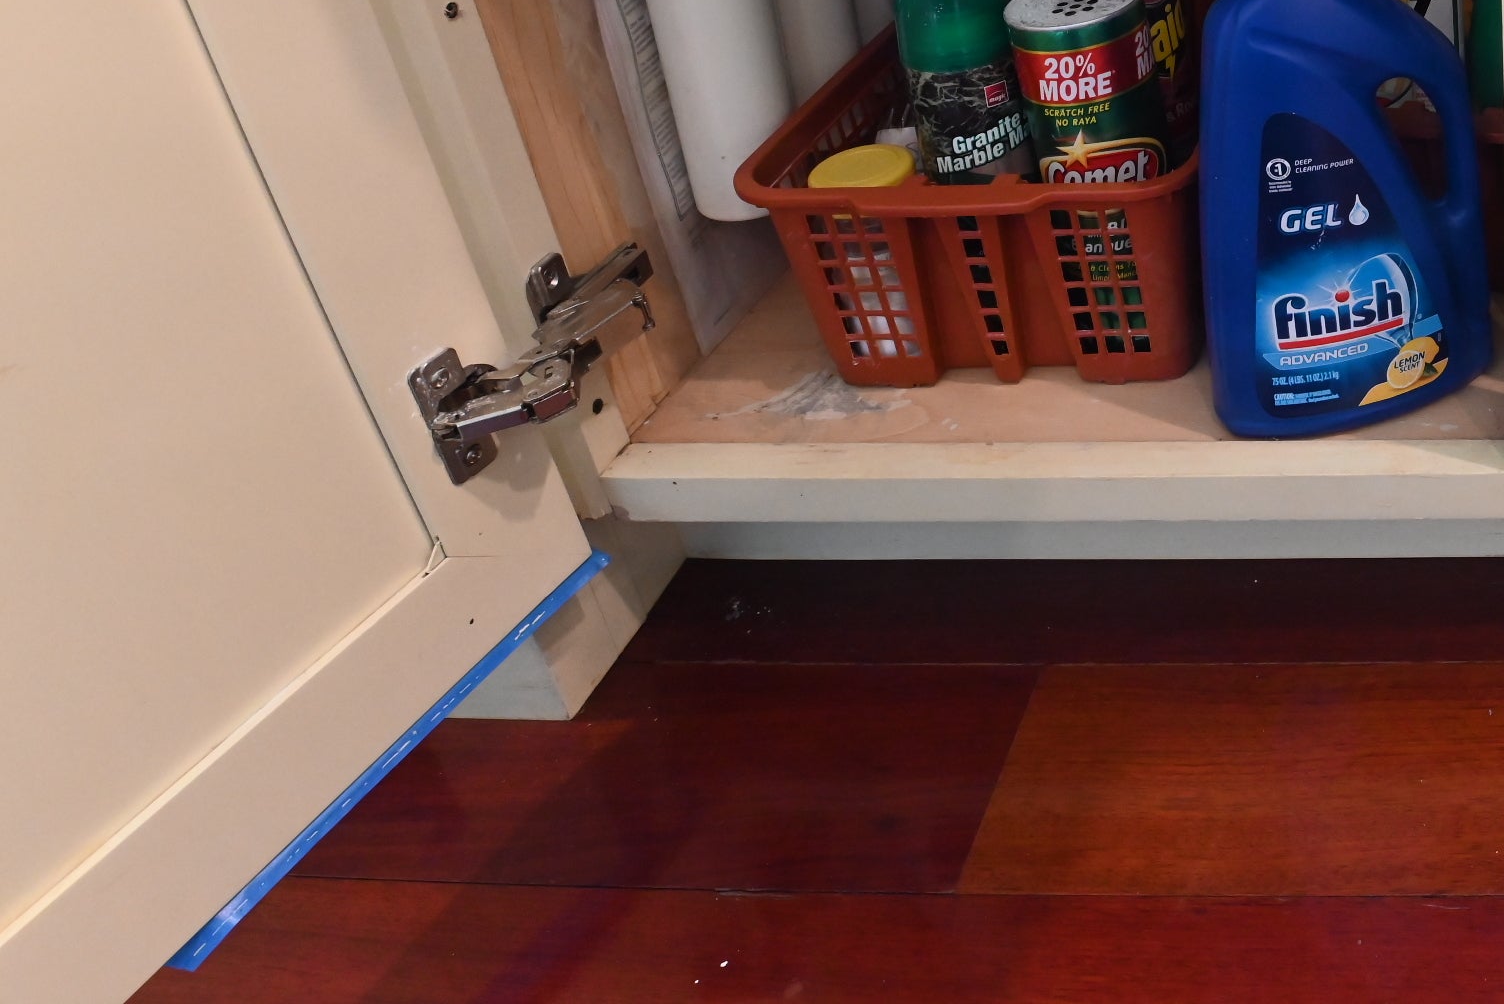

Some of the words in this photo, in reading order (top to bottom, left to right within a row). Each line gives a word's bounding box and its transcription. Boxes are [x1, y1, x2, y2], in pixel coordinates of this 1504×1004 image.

[1043, 52, 1096, 80] 20%
[1044, 107, 1084, 117] SCRATCH
[1088, 102, 1111, 113] FREE
[1055, 119, 1069, 127] NO
[1072, 115, 1097, 127] RAYA
[952, 112, 1021, 155] Granite
[936, 141, 1005, 174] Marble
[1047, 150, 1150, 183] Comet
[1294, 158, 1313, 166] DEEP
[1295, 163, 1329, 174] CLEANING
[1329, 158, 1354, 169] POWER
[1280, 203, 1342, 233] GEL
[1272, 279, 1405, 341] finish
[1279, 342, 1369, 367] ADVANCED
[1393, 351, 1426, 370] LEMON
[1399, 360, 1421, 374] SCENT
